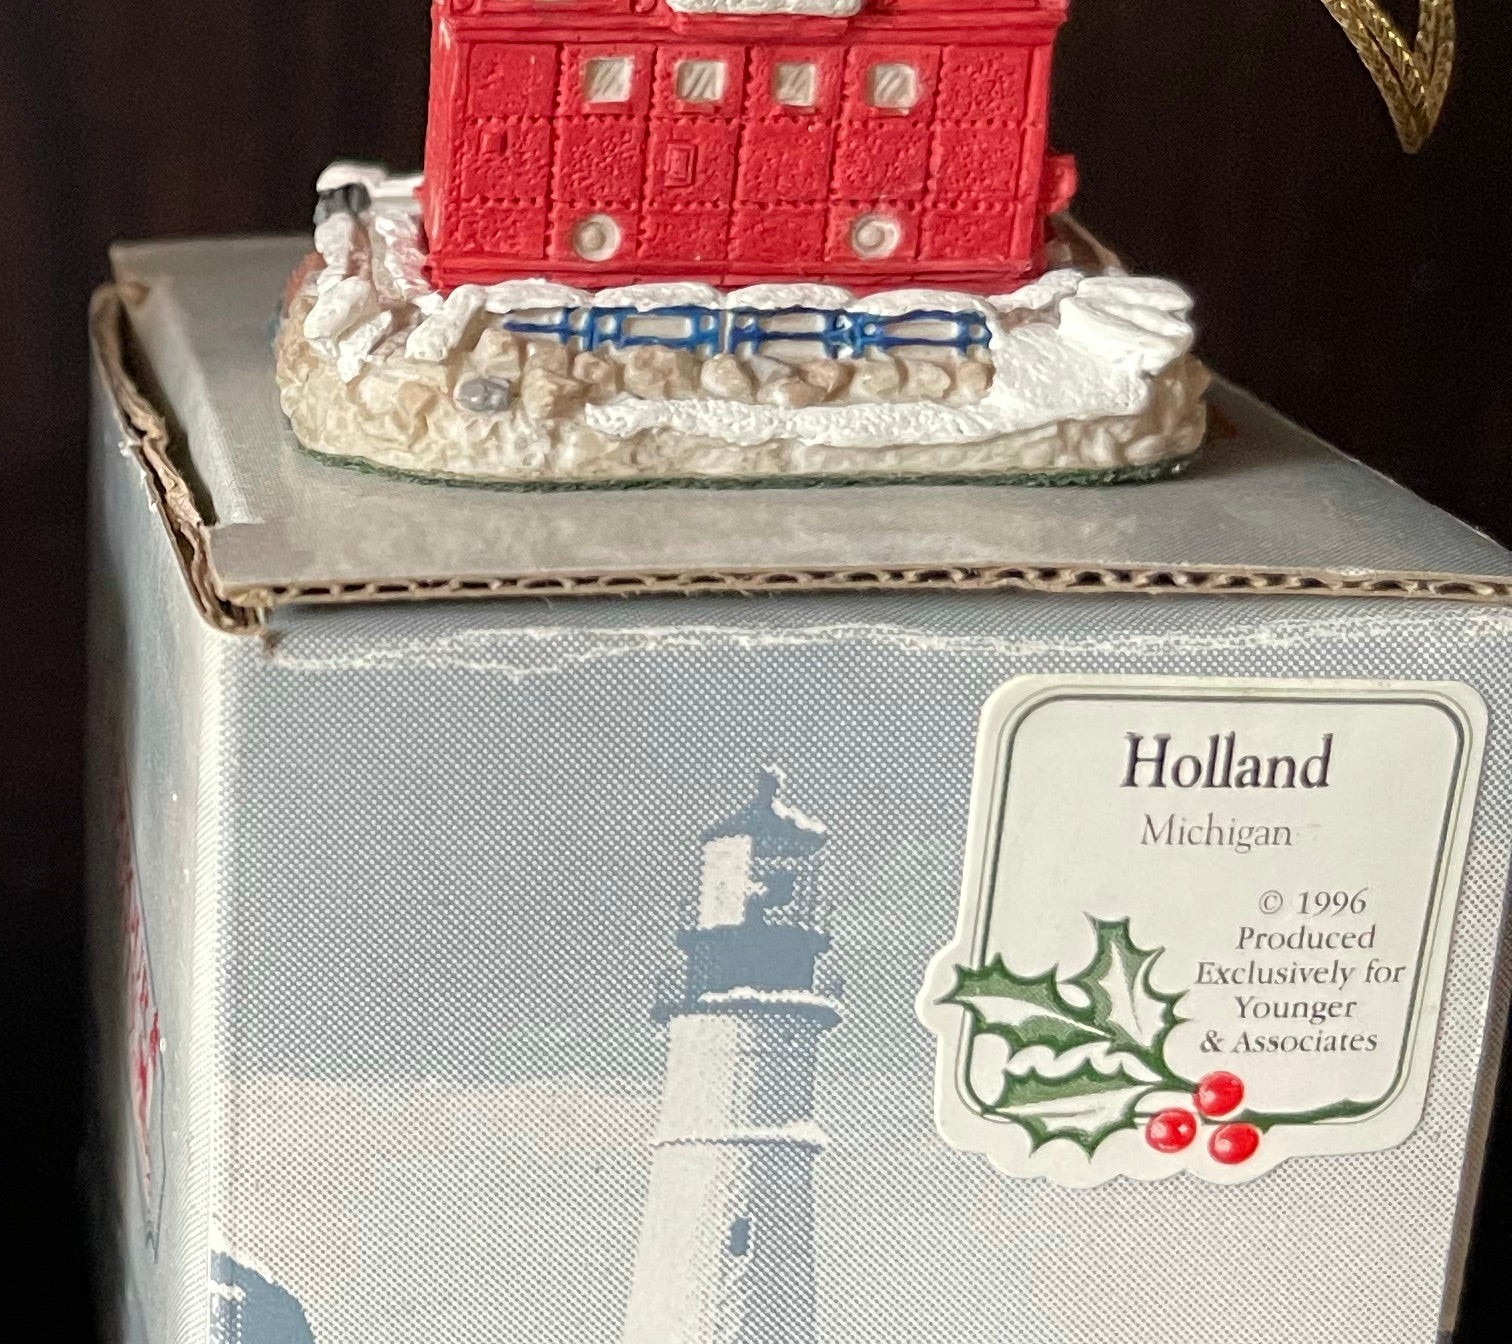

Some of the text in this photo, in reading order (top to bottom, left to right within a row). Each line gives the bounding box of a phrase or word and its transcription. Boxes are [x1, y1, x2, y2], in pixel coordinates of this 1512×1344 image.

[1120, 730, 1334, 789] Holland
[1140, 814, 1292, 852] Michigan
[1296, 887, 1368, 915] 1996
[1235, 925, 1376, 950] Produced
[1194, 960, 1407, 989] Exclusively for
[1233, 996, 1357, 1024] Younger
[1199, 1030, 1378, 1053] & Associates
